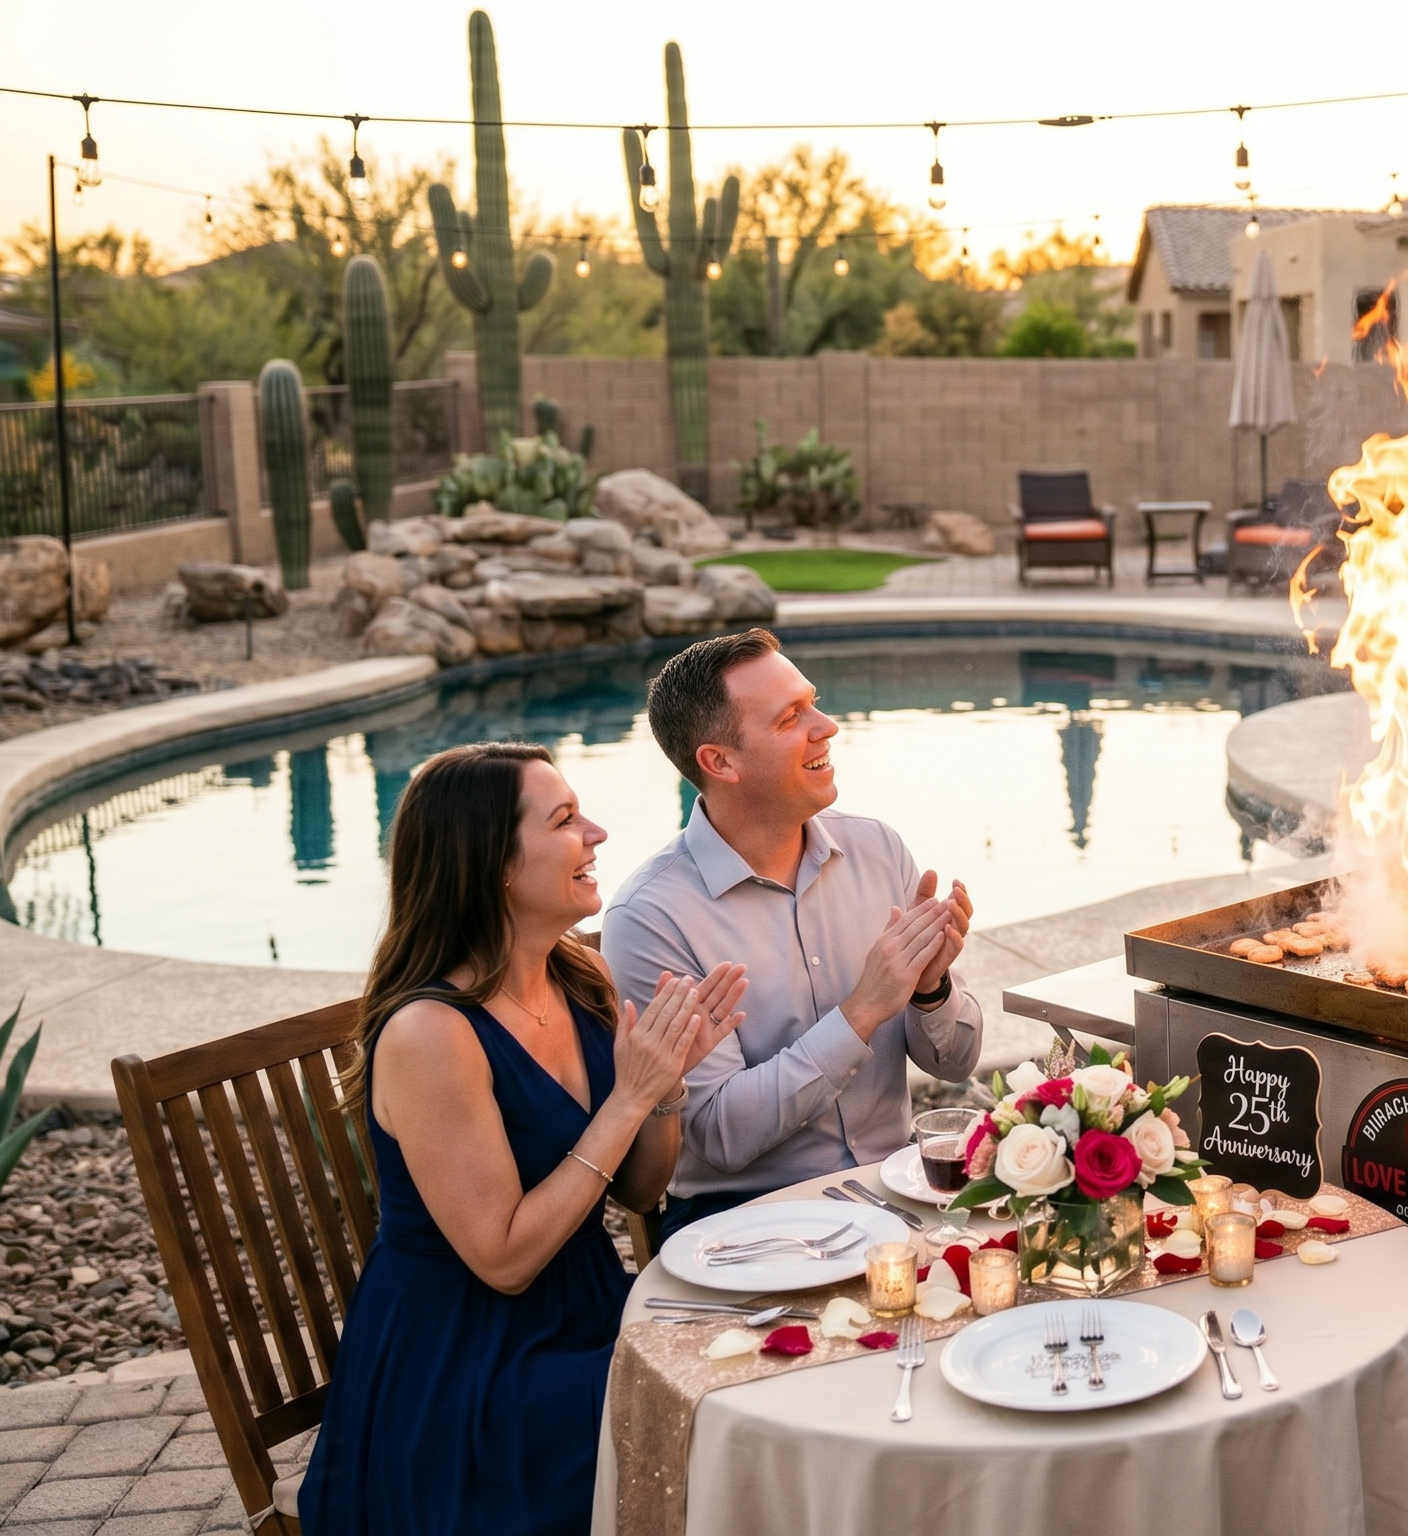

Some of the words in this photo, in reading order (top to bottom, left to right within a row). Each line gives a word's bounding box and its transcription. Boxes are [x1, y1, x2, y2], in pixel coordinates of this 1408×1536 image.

[1223, 1054, 1291, 1100] Happy
[1228, 1092, 1291, 1135] 25th
[1203, 1125, 1315, 1178] Anniversary
[1352, 1157, 1407, 1197] LOVE
